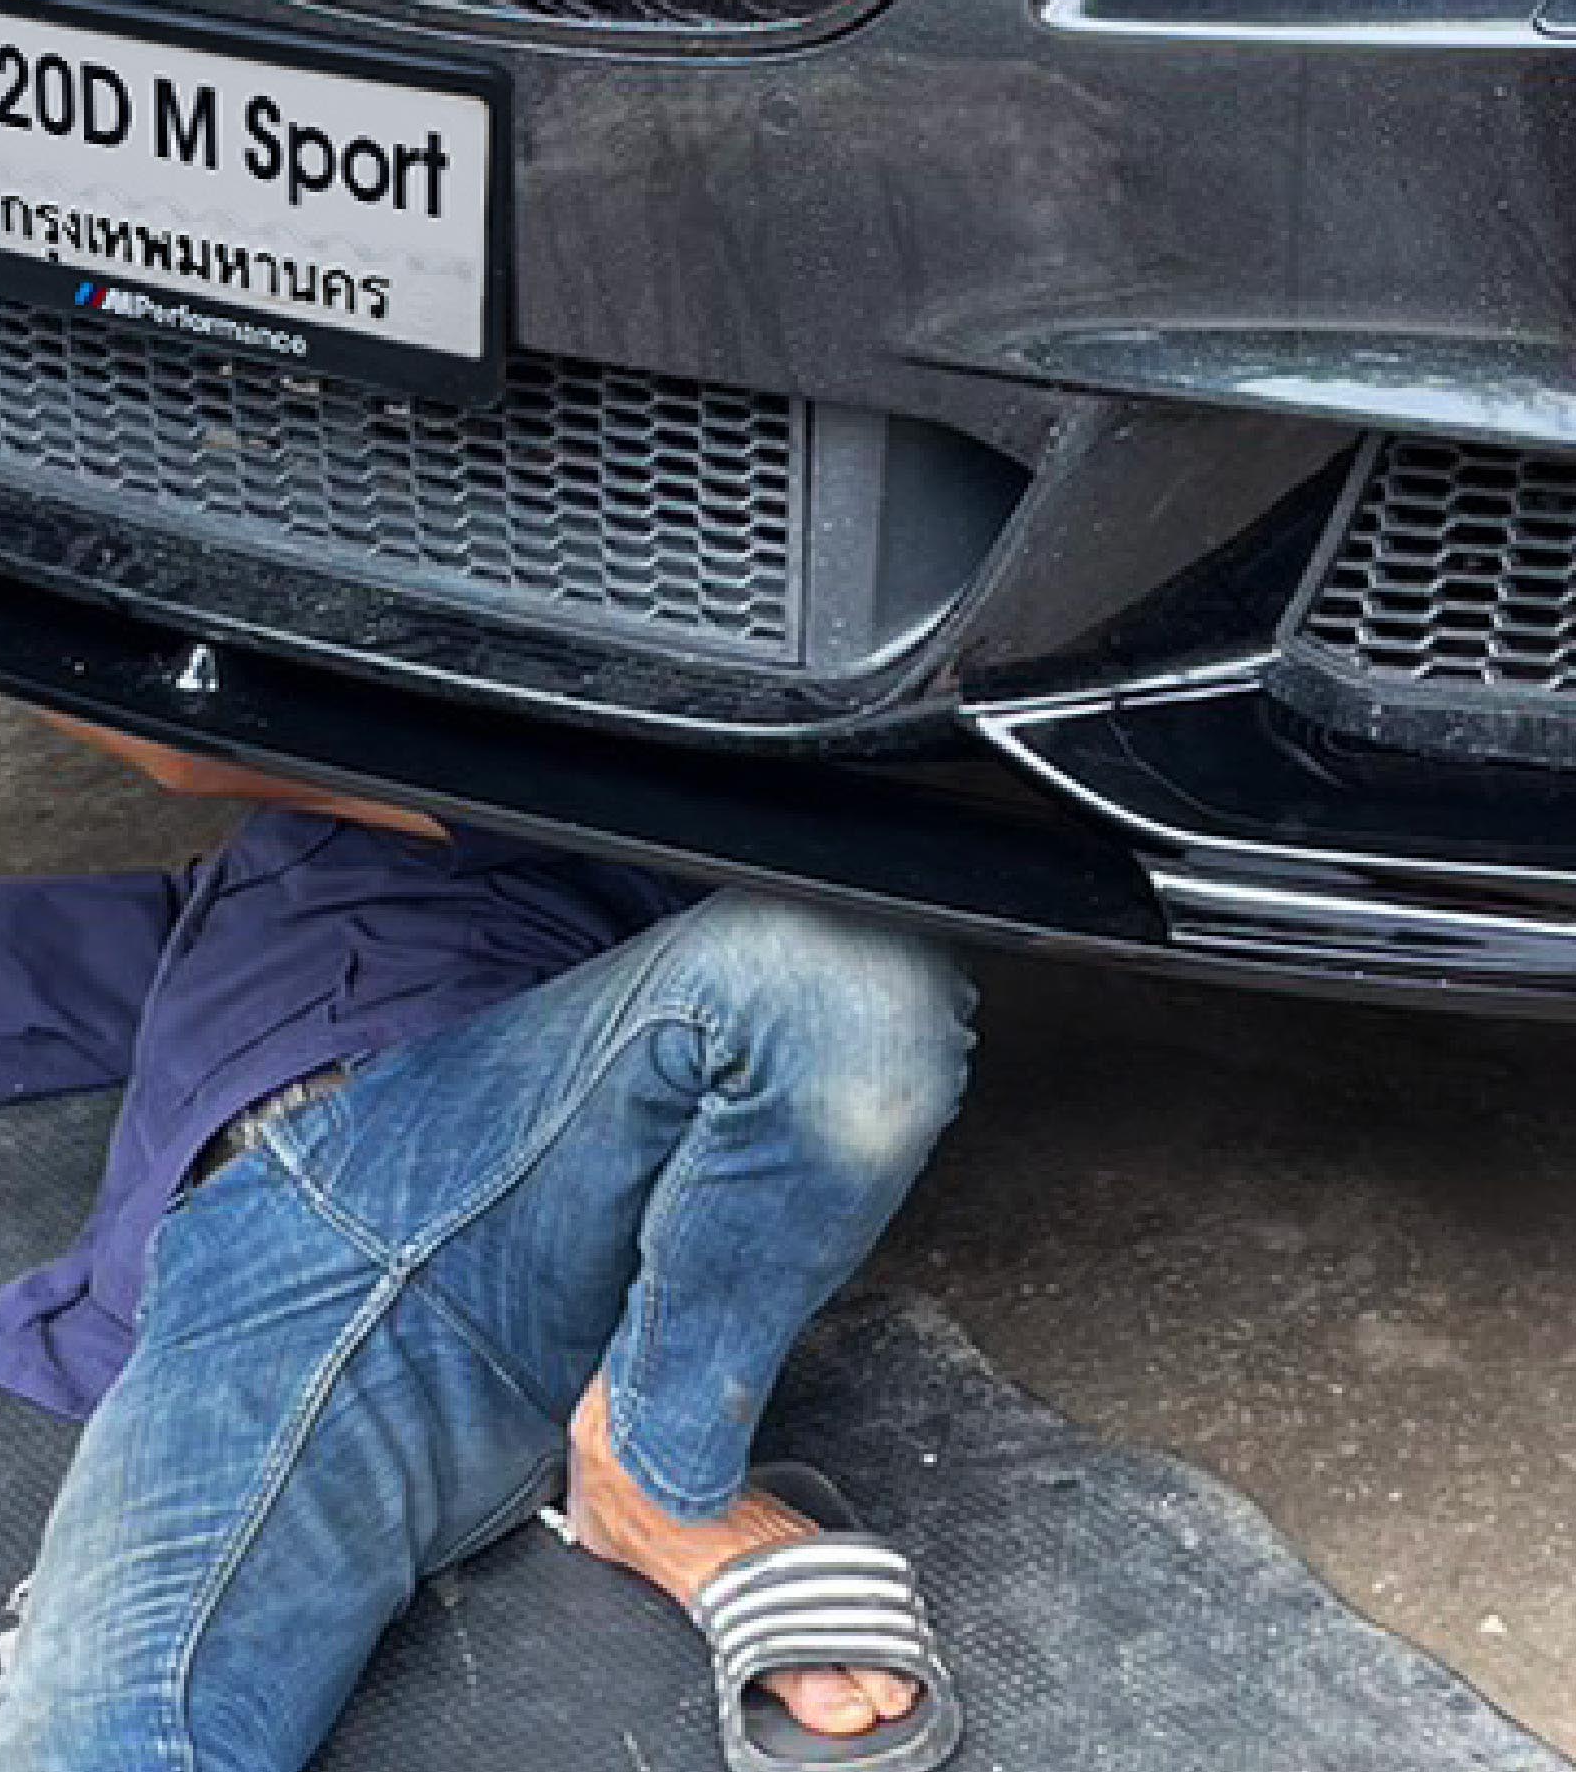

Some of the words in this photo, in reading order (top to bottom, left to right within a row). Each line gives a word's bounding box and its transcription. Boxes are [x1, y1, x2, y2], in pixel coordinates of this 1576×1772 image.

[153, 78, 219, 171] M
[243, 94, 450, 218] Sport
[0, 195, 392, 319] กรุงเทพมหานคร
